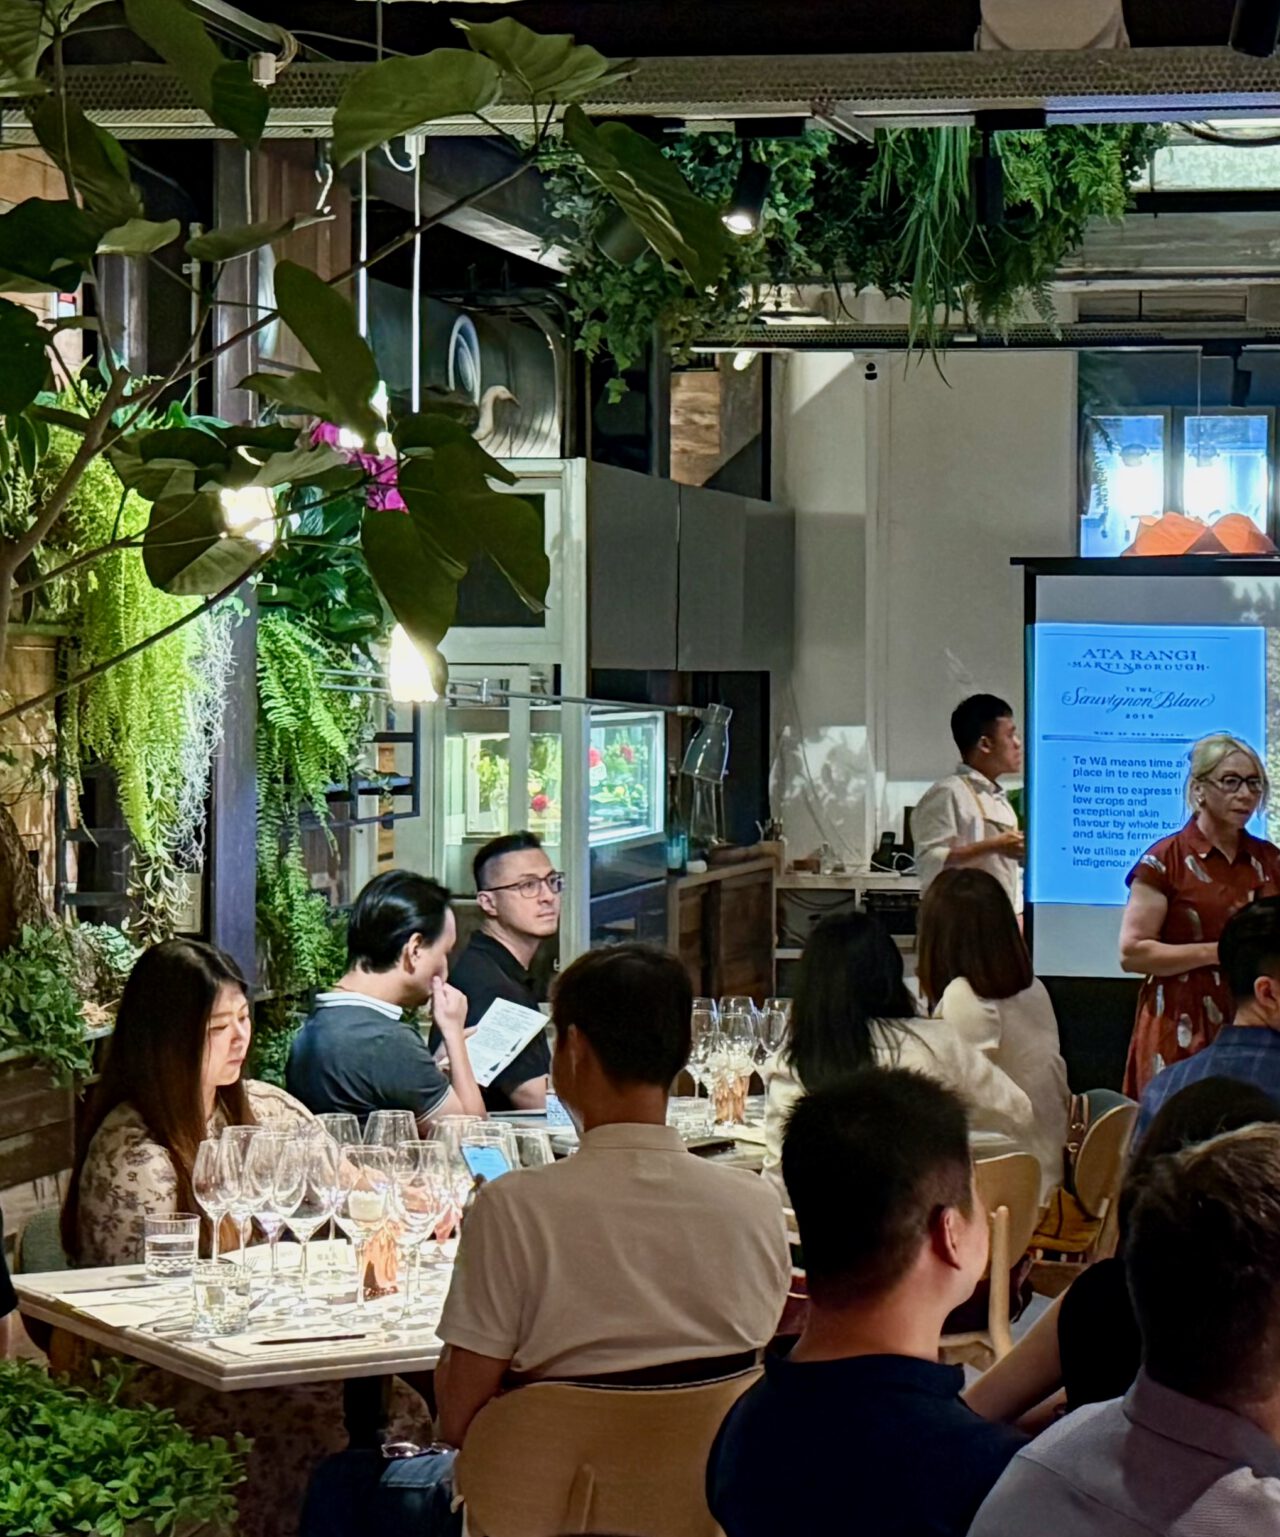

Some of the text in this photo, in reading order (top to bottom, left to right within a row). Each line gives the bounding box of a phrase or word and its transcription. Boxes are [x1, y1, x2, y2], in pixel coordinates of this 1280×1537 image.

[1082, 649, 1197, 661] ATA RANGI
[1062, 686, 1216, 714] Sauvignon Blanc
[1073, 756, 1087, 766] Te
[1110, 758, 1147, 768] means
[1149, 758, 1173, 768] time
[1073, 768, 1103, 778] place
[1105, 768, 1115, 778] in
[1118, 769, 1129, 778] te
[1132, 770, 1149, 779] reo
[1073, 783, 1091, 793] We
[1094, 784, 1115, 794] aim
[1117, 785, 1129, 795] to
[1131, 787, 1173, 797] express
[1073, 795, 1148, 807] low crops and
[1073, 807, 1160, 819] exceptional skin
[1073, 817, 1110, 828] flavour
[1113, 819, 1126, 830] by
[1129, 820, 1159, 830] whole
[1073, 830, 1094, 839] and
[1096, 830, 1125, 840] skins
[1073, 845, 1091, 855] We
[1094, 846, 1127, 856] utilise
